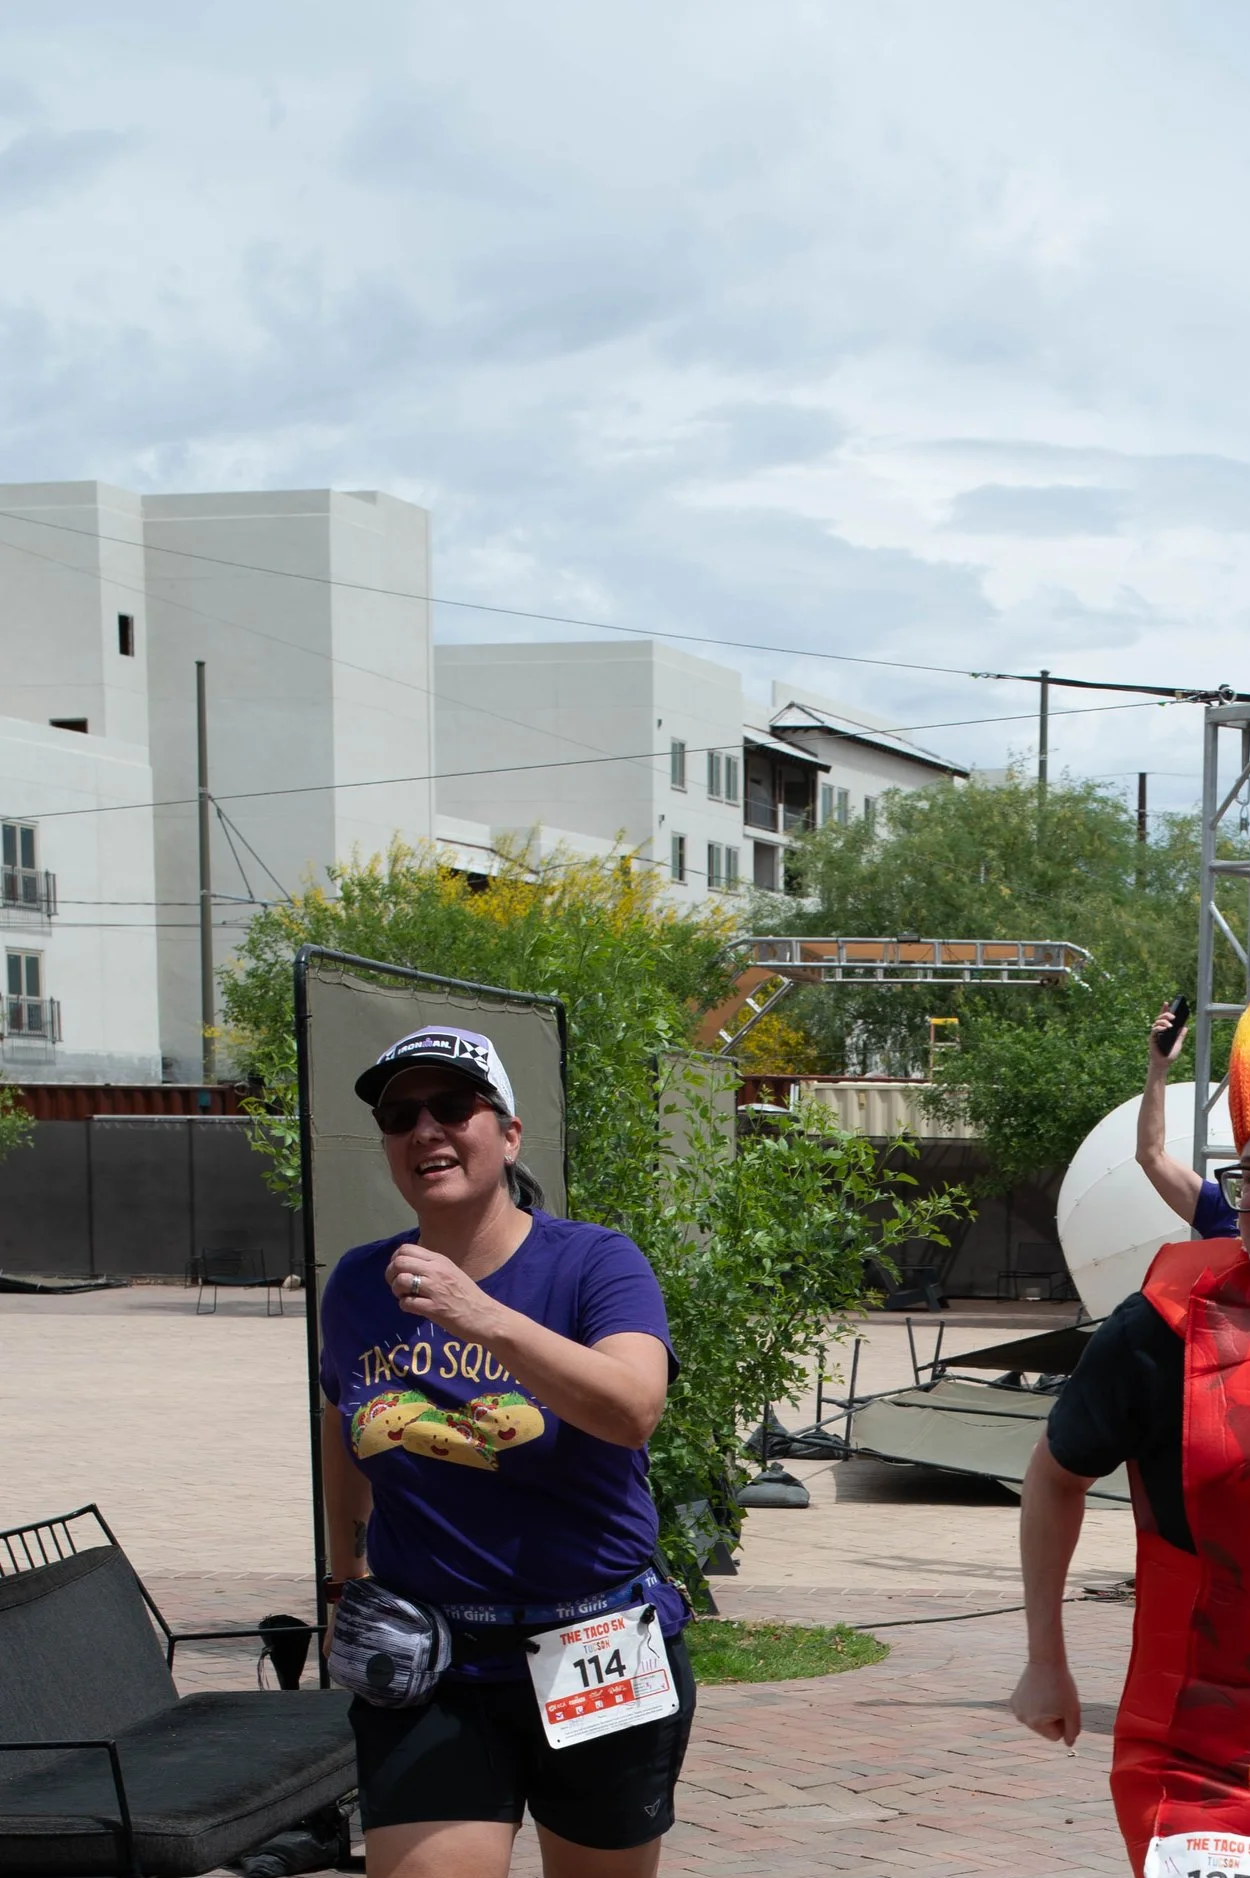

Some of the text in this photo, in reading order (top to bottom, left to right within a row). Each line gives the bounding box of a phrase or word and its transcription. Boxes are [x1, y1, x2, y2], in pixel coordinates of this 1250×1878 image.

[358, 1342, 520, 1386] TACO SQU
[464, 1610, 497, 1622] Girls
[556, 1599, 608, 1619] Tri Girls
[560, 1618, 626, 1645] THE TACO 5K
[573, 1648, 626, 1688] 114
[1186, 1838, 1210, 1851] THE
[1214, 1839, 1245, 1853] TACO
